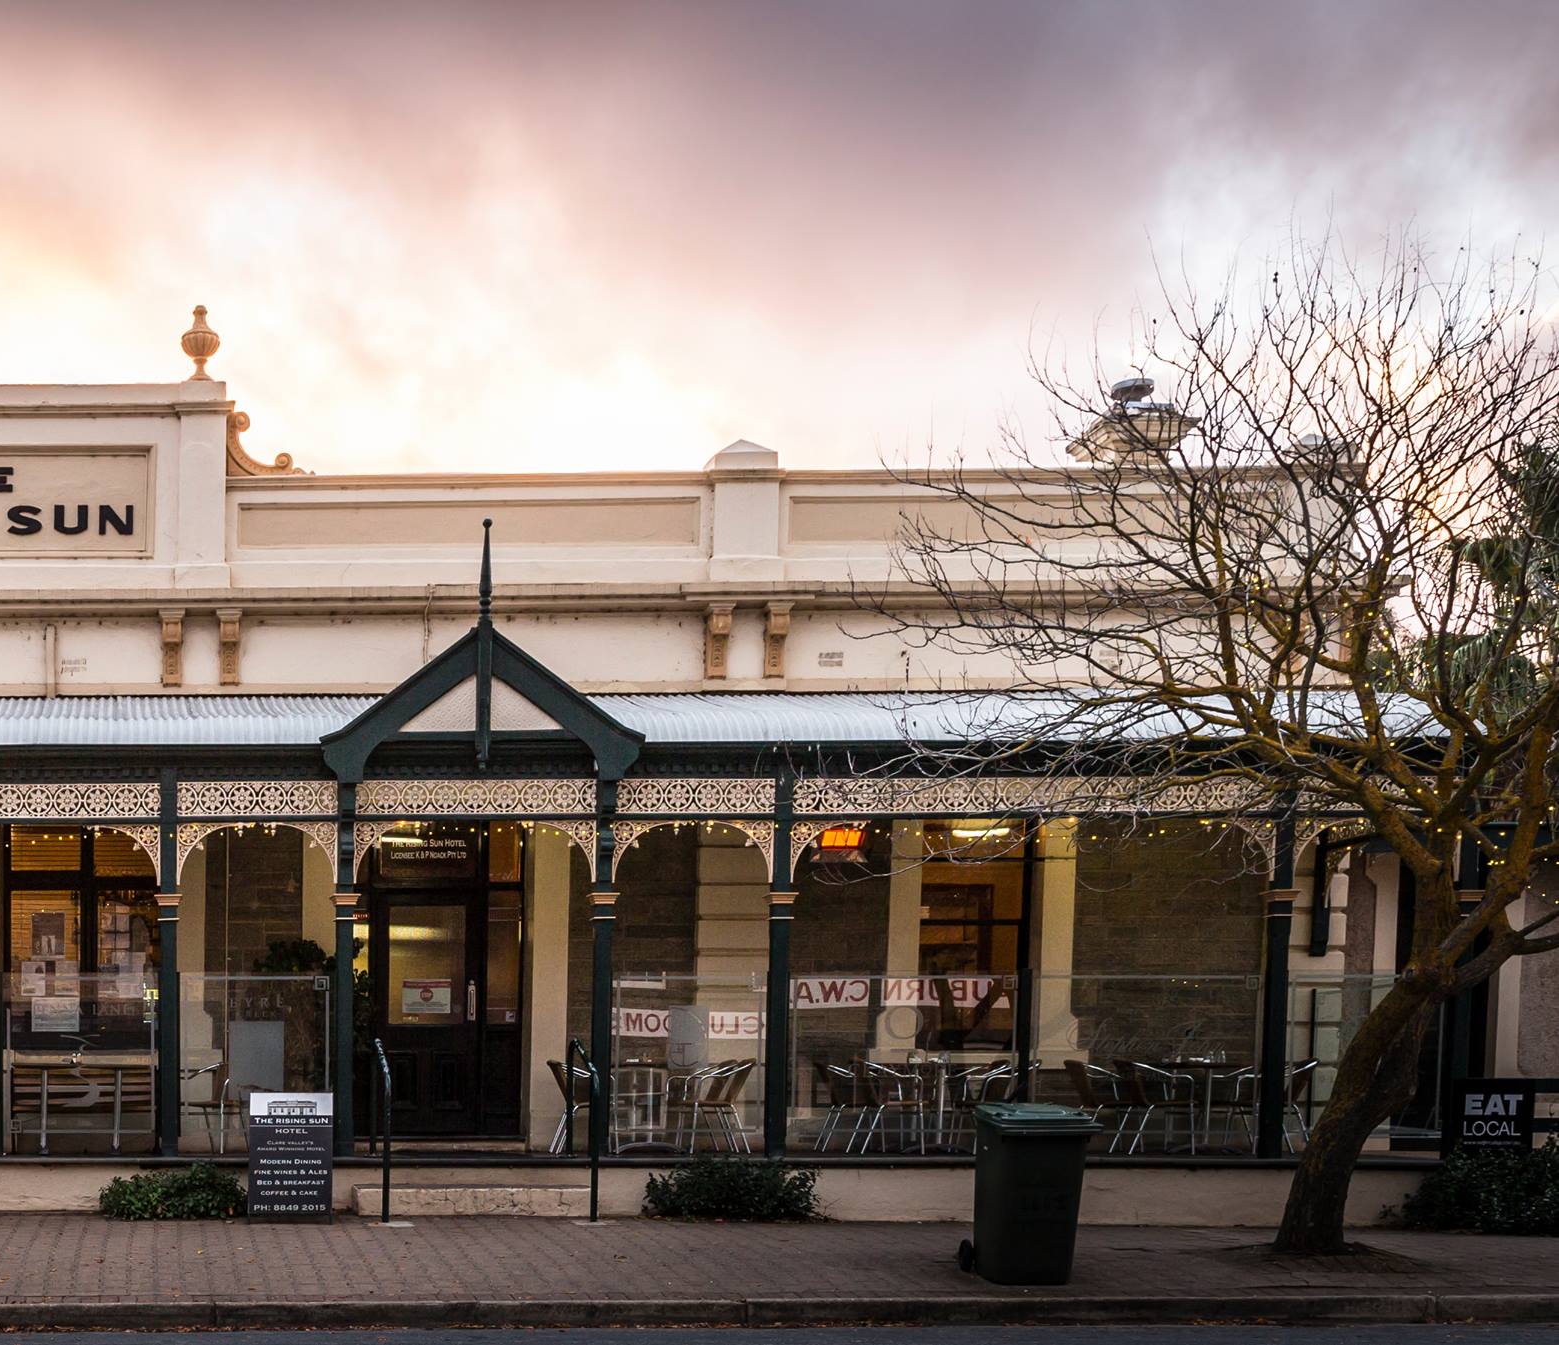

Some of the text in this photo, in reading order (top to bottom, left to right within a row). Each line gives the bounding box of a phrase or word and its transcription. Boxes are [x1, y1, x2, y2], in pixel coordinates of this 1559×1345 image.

[7, 504, 134, 535] SUN
[429, 838, 444, 847] SUN
[445, 839, 467, 847] HOTEL
[391, 851, 415, 860] LICENSEE
[415, 851, 420, 859] K
[1464, 1094, 1523, 1115] EAT
[1463, 1121, 1521, 1136] LOCAL
